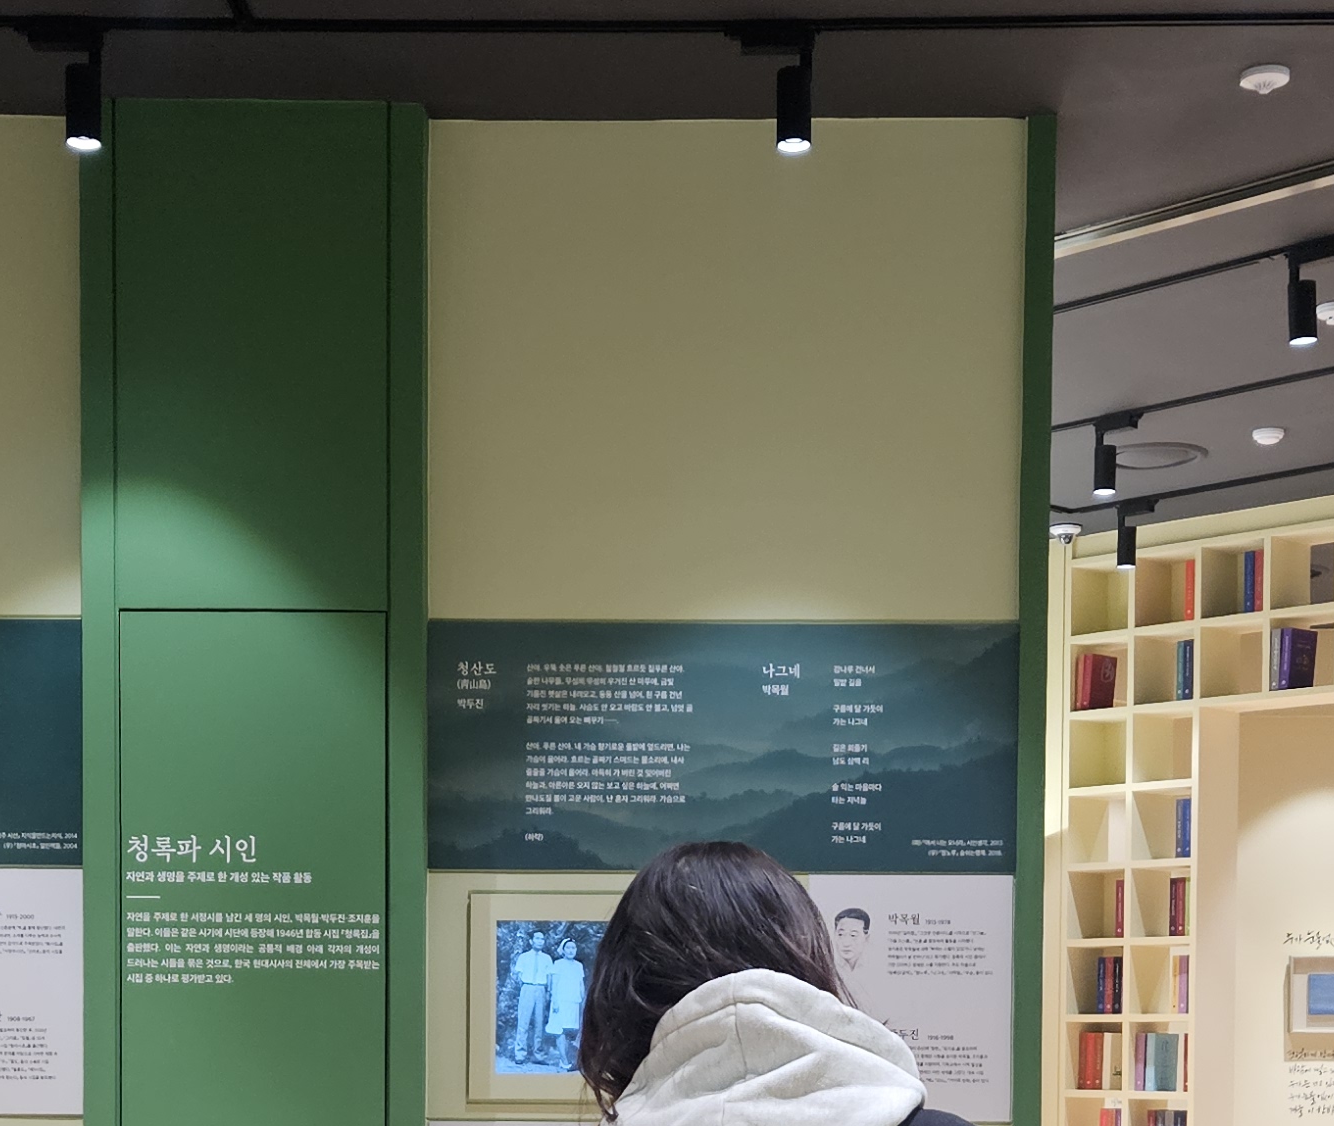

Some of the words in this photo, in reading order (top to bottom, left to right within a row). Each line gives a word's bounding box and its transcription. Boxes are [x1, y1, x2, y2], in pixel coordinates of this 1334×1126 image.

[457, 661, 497, 676] 청산도
[762, 663, 800, 679] 나그네
[761, 684, 789, 696] 박목월
[457, 698, 484, 710] 박두진
[127, 834, 201, 863] 청록파
[210, 835, 256, 863] 시인
[125, 870, 155, 883] 자연과
[156, 870, 185, 883] 생명을
[187, 871, 216, 883] 주제로
[217, 871, 228, 883] 한
[229, 871, 249, 883] 개성
[251, 871, 270, 883] 있는
[272, 871, 291, 884] 작품
[293, 872, 312, 884] 활동
[126, 911, 151, 924] 자연을
[153, 911, 178, 924] 주제로
[179, 911, 189, 924] 한
[190, 911, 223, 924] 서정시를
[225, 911, 242, 924] 남긴
[244, 911, 253, 924] 세
[254, 911, 272, 924] 명의
[273, 911, 293, 924] 시인,
[888, 912, 920, 926] 박목월
[126, 927, 154, 938] 말한다.
[154, 927, 180, 938] 이들은
[180, 927, 197, 938] 같은
[198, 927, 223, 938] 시기에
[224, 927, 249, 938] 시단에
[250, 927, 275, 939] 등장해
[305, 928, 322, 939] 합동
[323, 928, 340, 939] 시집
[164, 942, 182, 954] 이는
[185, 943, 210, 954] 자연과
[213, 943, 254, 954] 생명이라는
[286, 944, 303, 954] 배경
[306, 944, 324, 954] 아래
[327, 944, 352, 954] 각자의
[355, 944, 380, 955] 개성이
[126, 957, 159, 969] 드러나는
[160, 957, 186, 969] 시들을
[205, 958, 233, 969] 것으로,
[234, 958, 251, 969] 한국
[295, 959, 328, 969] 전체에서
[329, 959, 346, 970] 가장
[347, 959, 380, 970] 주목받는
[126, 973, 144, 984] 시집
[144, 973, 154, 984] 중
[154, 973, 180, 984] 하나로
[180, 973, 214, 984] 평가받고
[214, 973, 234, 984] 있다.
